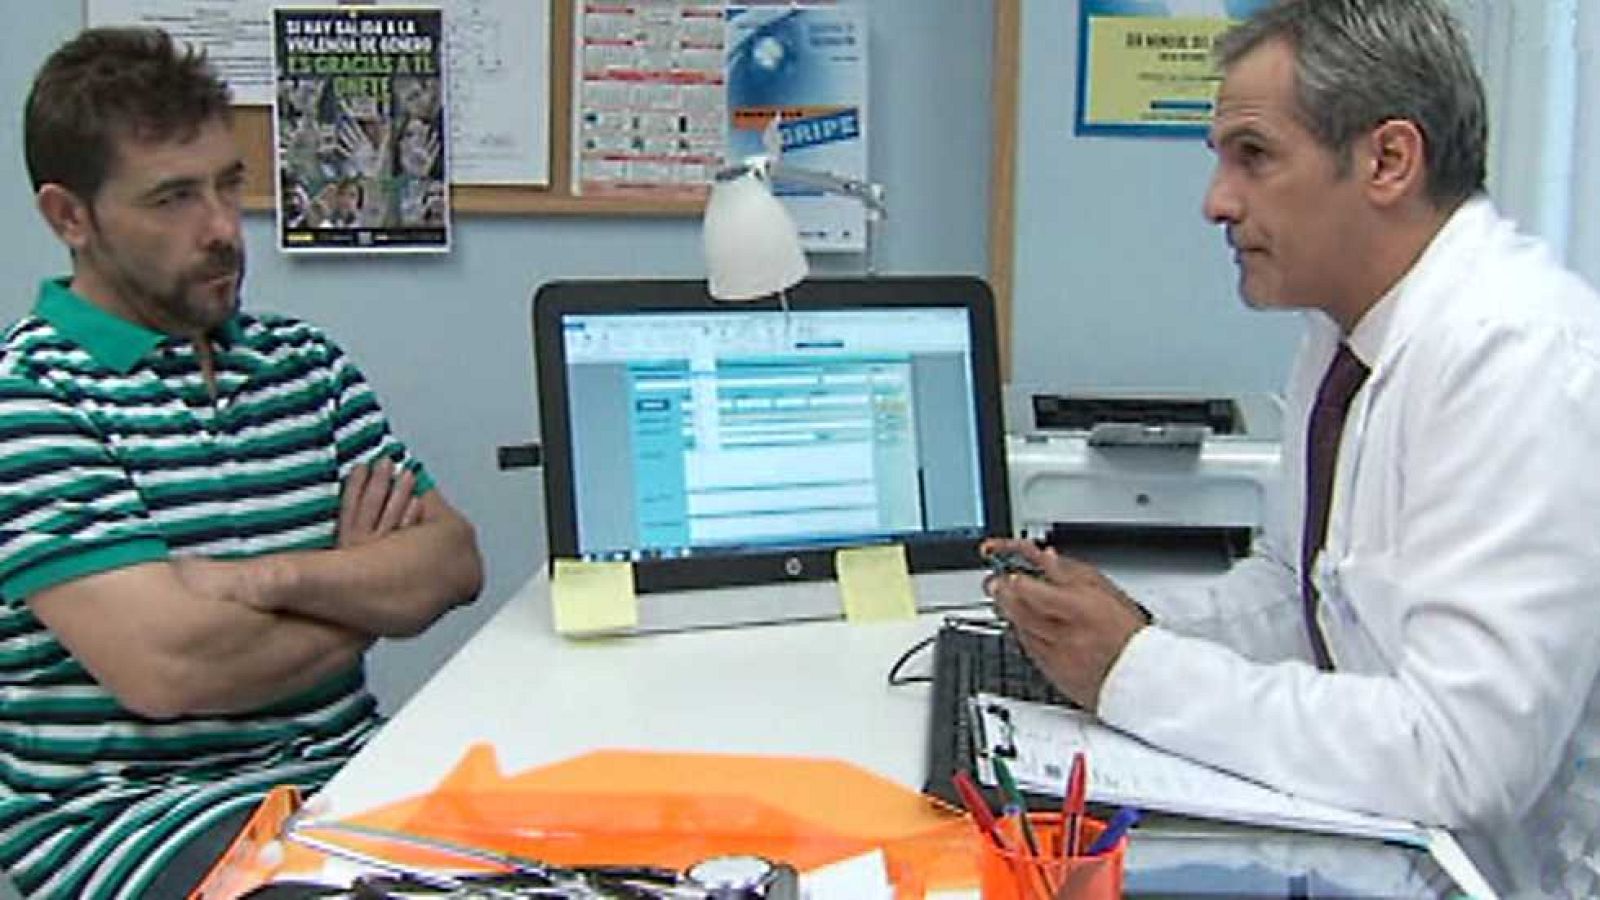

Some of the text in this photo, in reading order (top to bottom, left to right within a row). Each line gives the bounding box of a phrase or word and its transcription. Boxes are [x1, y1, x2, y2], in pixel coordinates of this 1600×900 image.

[304, 20, 333, 35] HAY
[335, 20, 383, 35] SALIDA
[397, 20, 416, 35] LA
[286, 36, 357, 53] VIOLENCIA
[359, 36, 379, 53] DE
[287, 55, 312, 74] ES
[314, 55, 394, 74] GRACIAS
